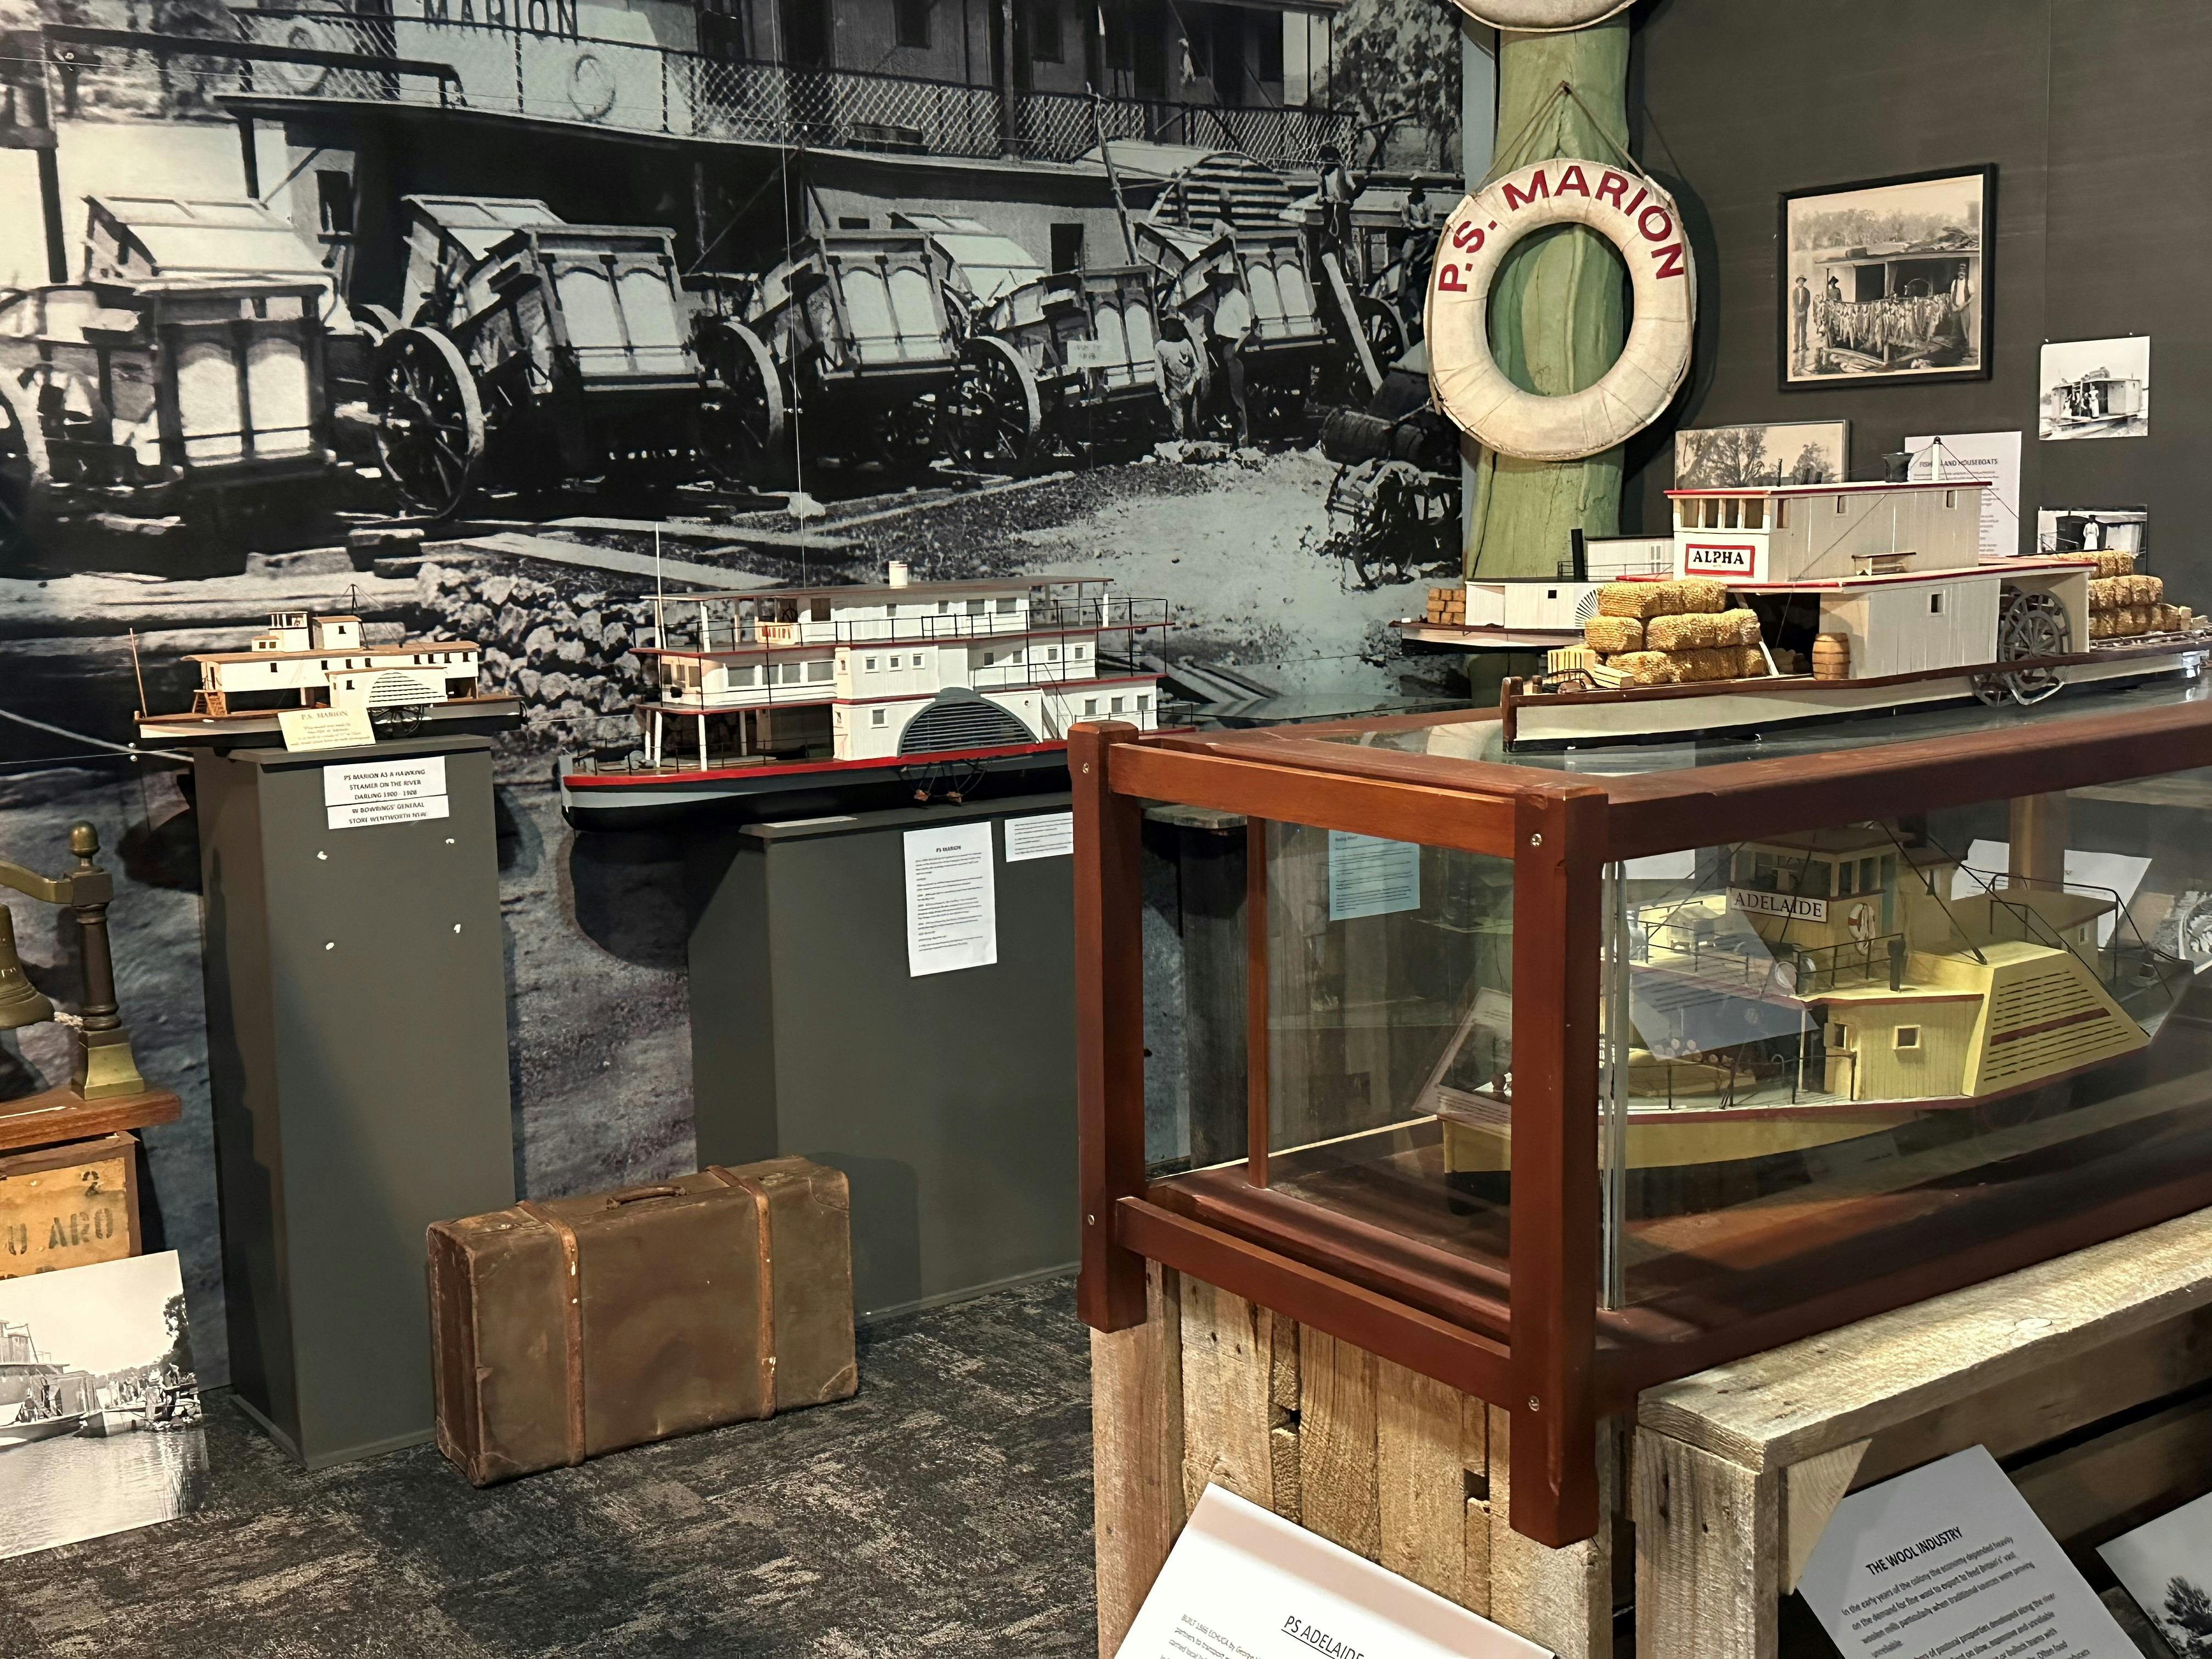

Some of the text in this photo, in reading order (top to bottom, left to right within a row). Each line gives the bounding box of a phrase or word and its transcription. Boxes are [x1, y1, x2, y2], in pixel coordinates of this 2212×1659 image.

[1438, 165, 1684, 292] P.S. MARION
[1692, 550, 1744, 565] ALPHA
[317, 710, 348, 719] MARION
[1734, 892, 1822, 918] ADELAIDE
[1865, 1526, 1963, 1576] THE WOOL INDUSTRY
[1284, 1615, 1302, 1633] PS
